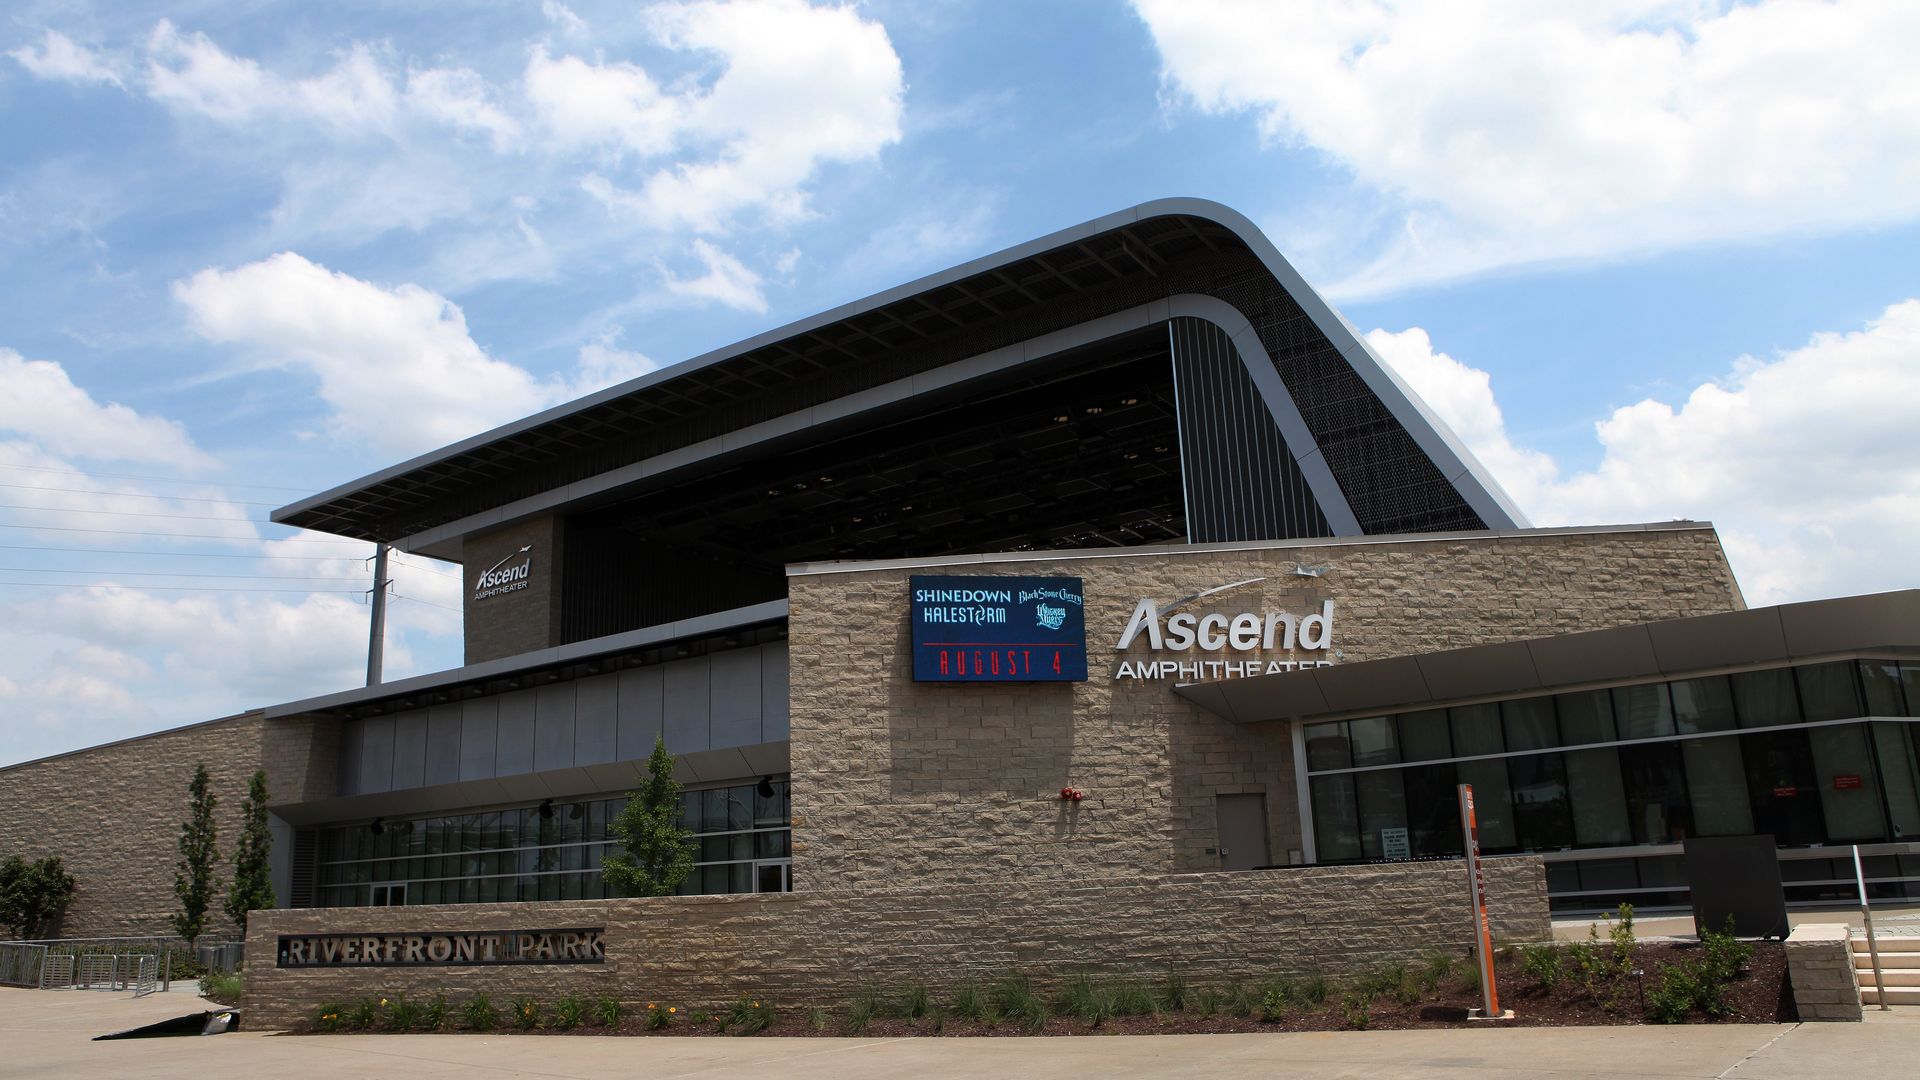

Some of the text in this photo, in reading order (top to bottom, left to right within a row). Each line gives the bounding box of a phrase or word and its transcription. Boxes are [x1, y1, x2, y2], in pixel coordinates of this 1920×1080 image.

[476, 558, 530, 590] Ascend
[474, 581, 528, 600] AMPHITHEATER
[916, 590, 1011, 603] SHINEDOWN
[1018, 587, 1082, 605] Black Stone Cherry
[924, 605, 1006, 626] HALESTORM
[1116, 598, 1334, 650] Ascend
[939, 650, 1062, 675] AUGUST 4
[289, 932, 605, 964] RIVERFRONT PARK
